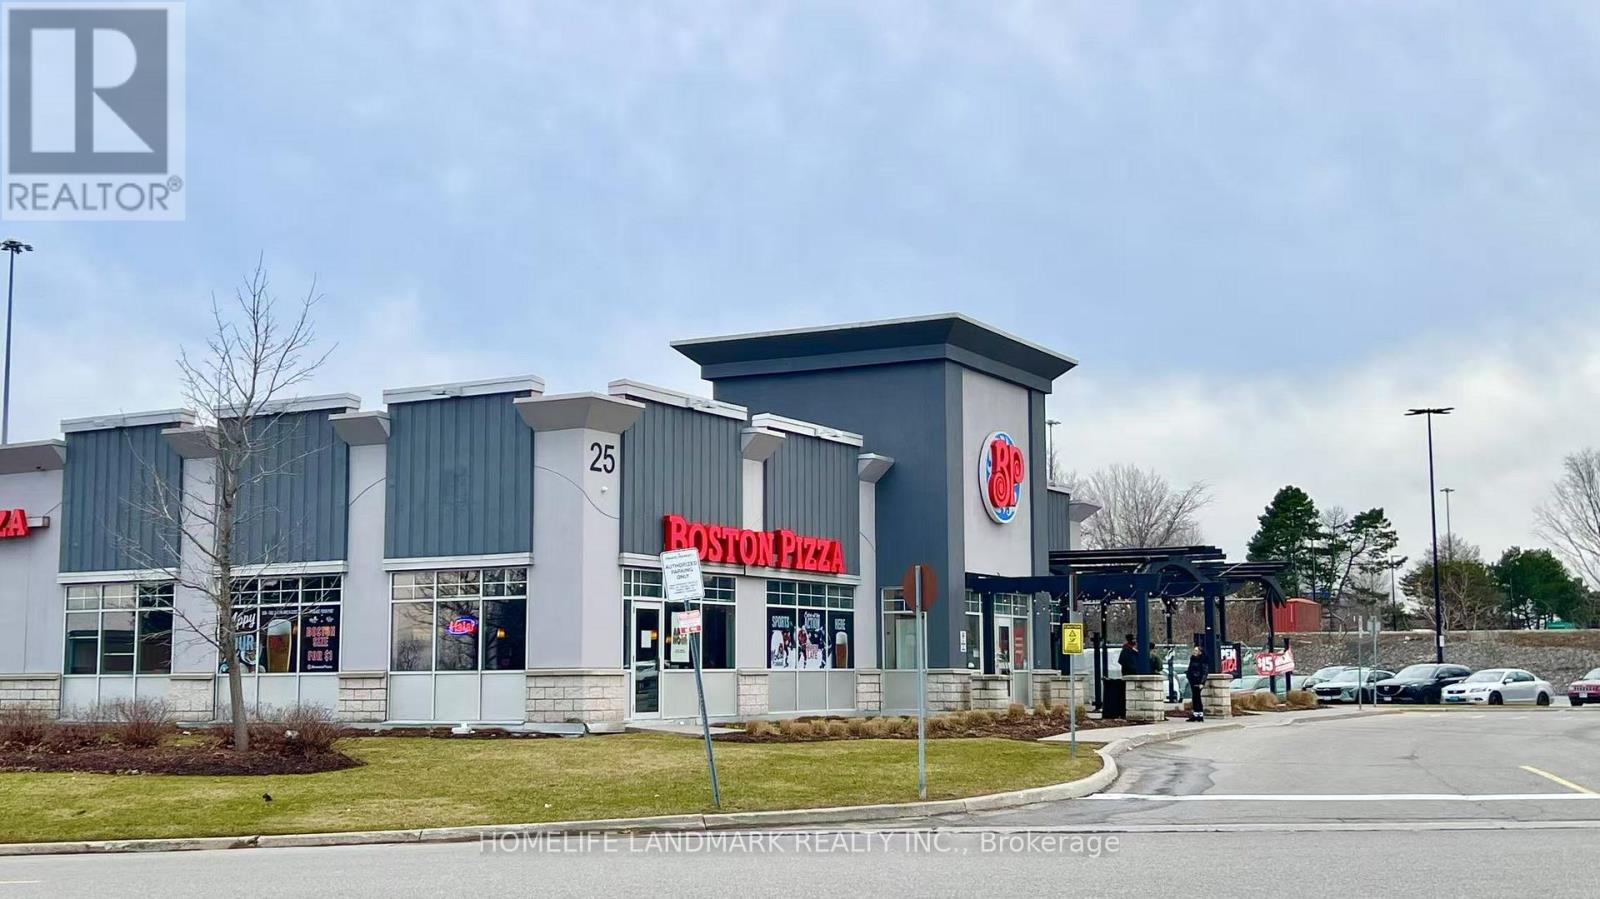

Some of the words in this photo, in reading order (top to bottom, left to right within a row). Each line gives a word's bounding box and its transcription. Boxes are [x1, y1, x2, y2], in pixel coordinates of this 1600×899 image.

[590, 442, 615, 474] 25
[987, 437, 1025, 508] BP
[663, 514, 774, 567] BOSTON
[774, 528, 846, 574] PIZZA
[665, 560, 698, 569] AUTHORIZED
[772, 615, 789, 628] SPORTS
[1220, 648, 1237, 661] PEN
[1257, 656, 1274, 672] $15
